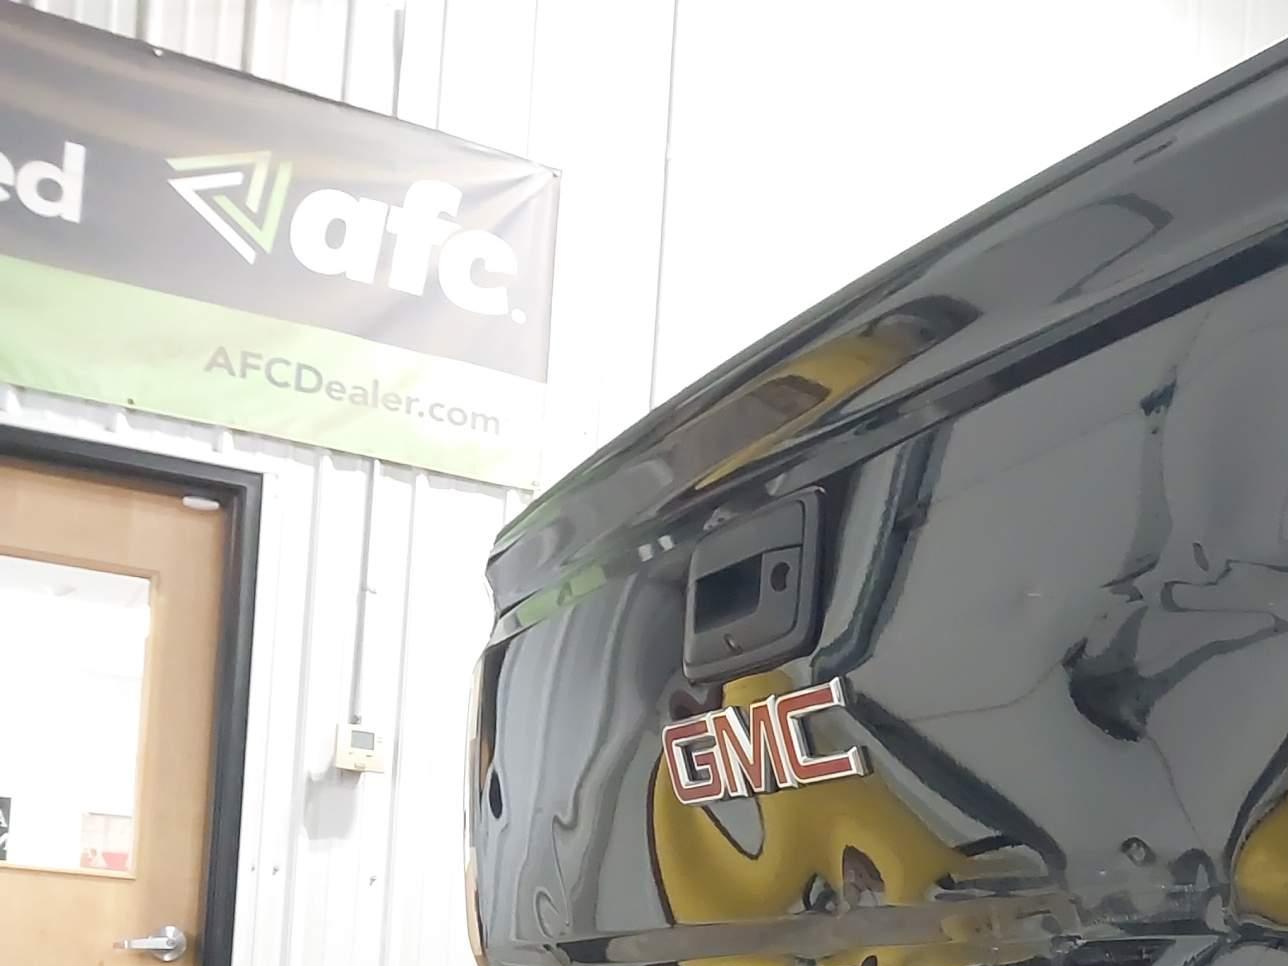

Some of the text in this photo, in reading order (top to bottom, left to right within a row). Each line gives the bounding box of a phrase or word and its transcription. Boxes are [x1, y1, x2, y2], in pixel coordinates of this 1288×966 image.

[0, 141, 87, 224] d
[204, 346, 501, 435] AFCDealer.com
[662, 676, 864, 805] GMC
